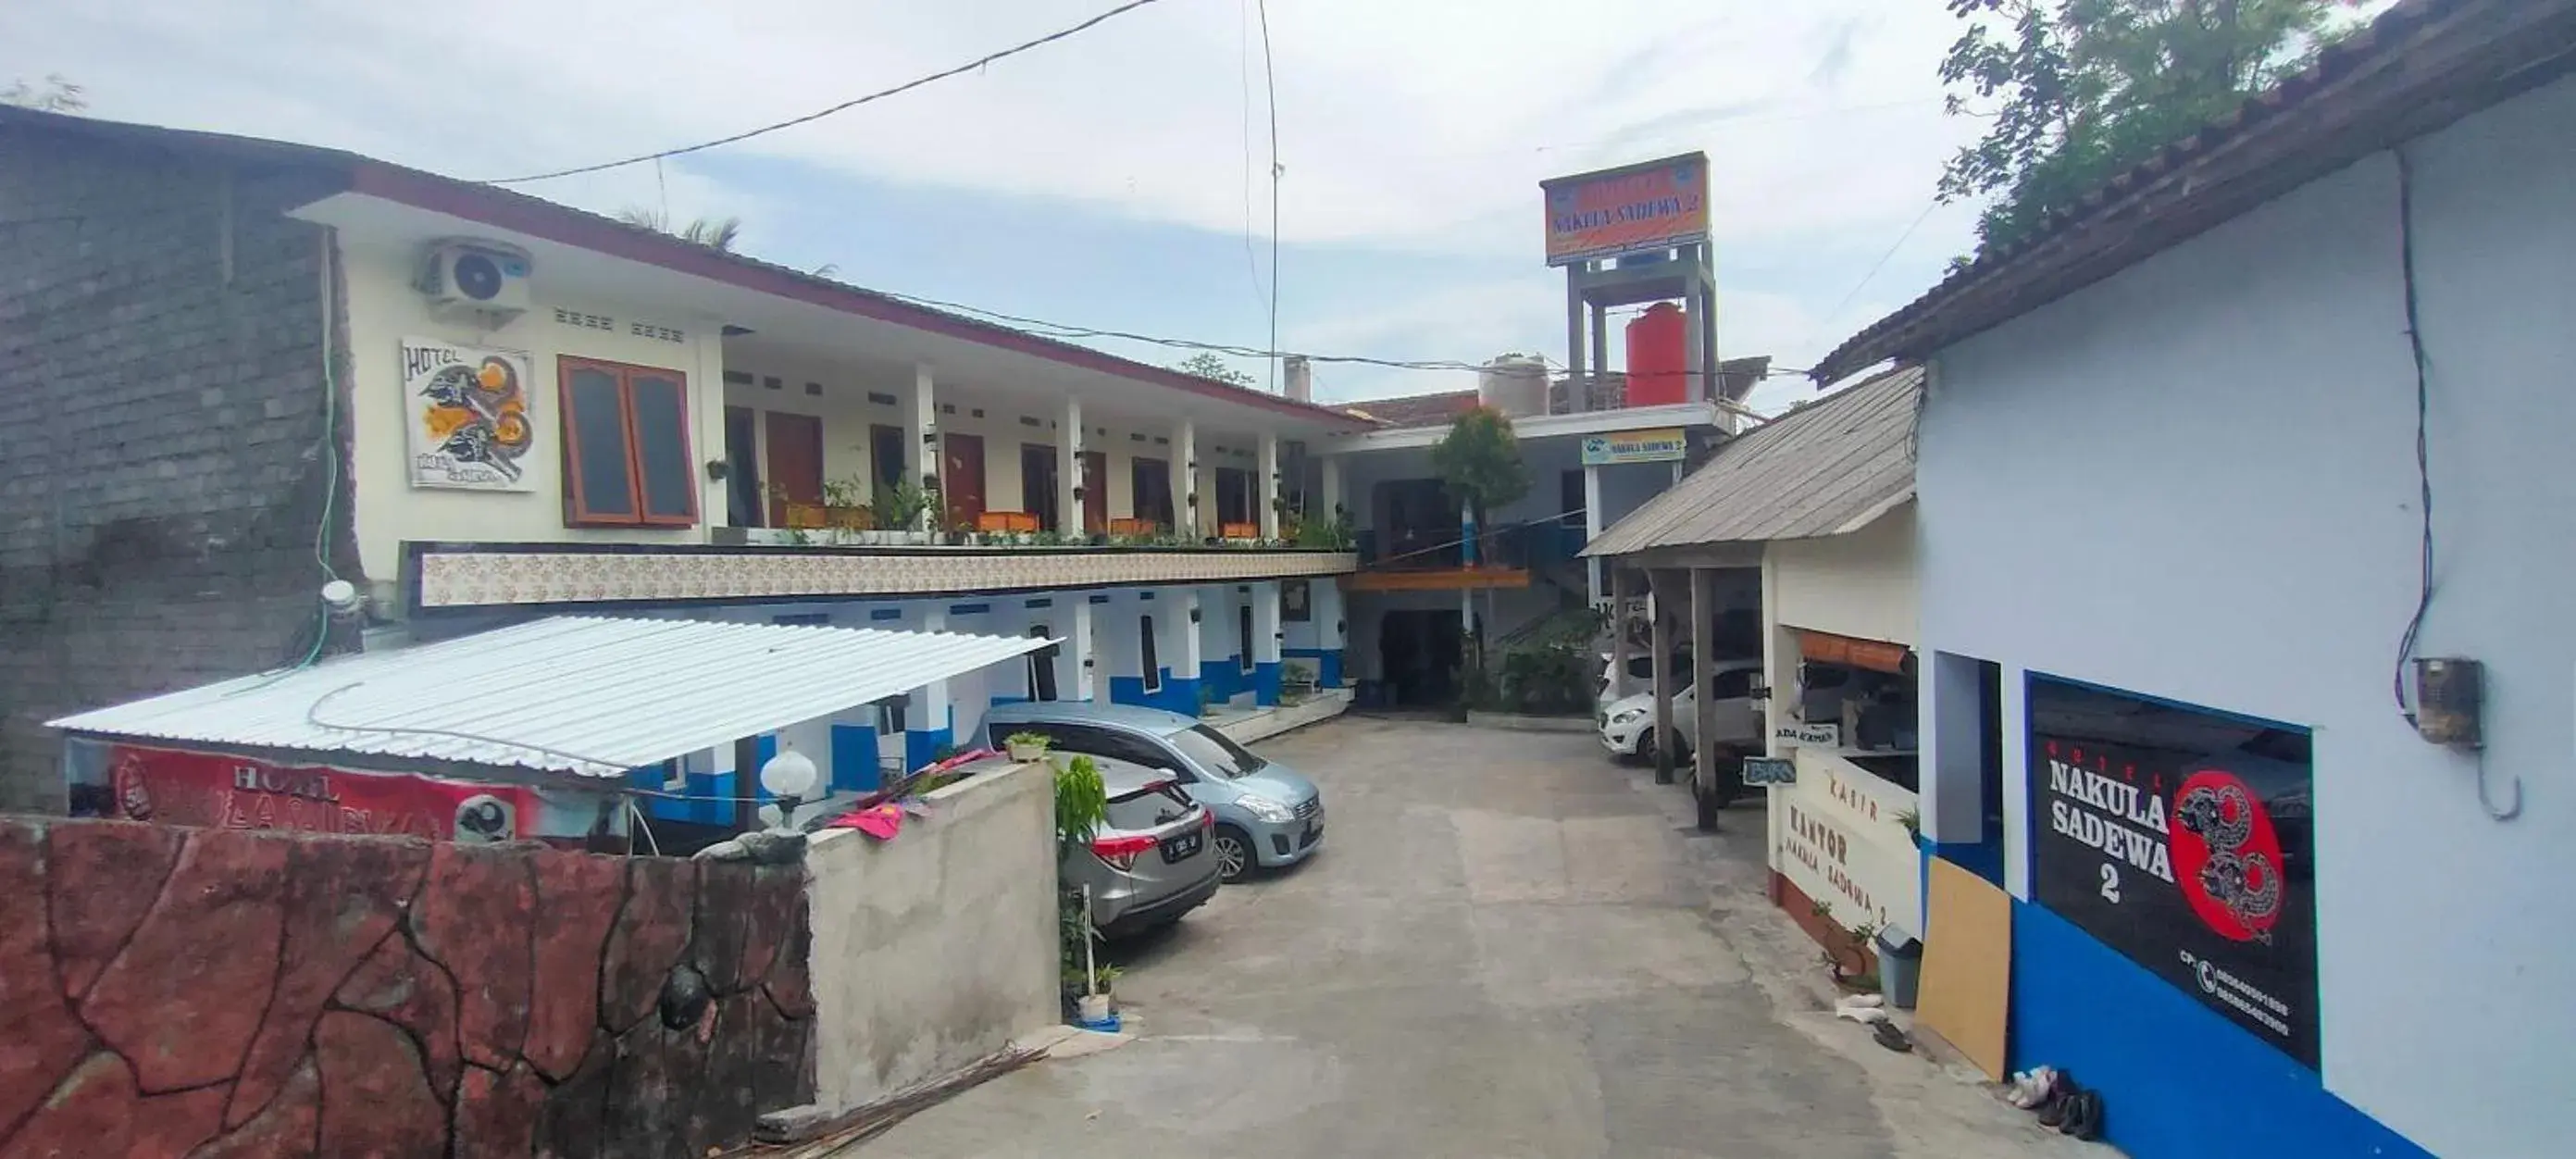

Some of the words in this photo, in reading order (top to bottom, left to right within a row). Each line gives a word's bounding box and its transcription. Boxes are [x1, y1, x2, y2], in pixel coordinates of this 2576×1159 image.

[1618, 193, 1682, 221] SADEWA
[1687, 193, 1700, 211] 2
[404, 346, 463, 381] HOTEL
[1775, 729, 1797, 738] ADA
[1829, 777, 1878, 822] KASIR
[2049, 759, 2170, 835] NAKULA
[1790, 804, 1847, 866] KANTOR
[2051, 799, 2174, 883] SADEWA
[1785, 837, 1819, 874] NAKULA
[1828, 865, 1873, 915] SADEWA
[1879, 905, 1886, 927] 2
[2099, 863, 2120, 904] 2
